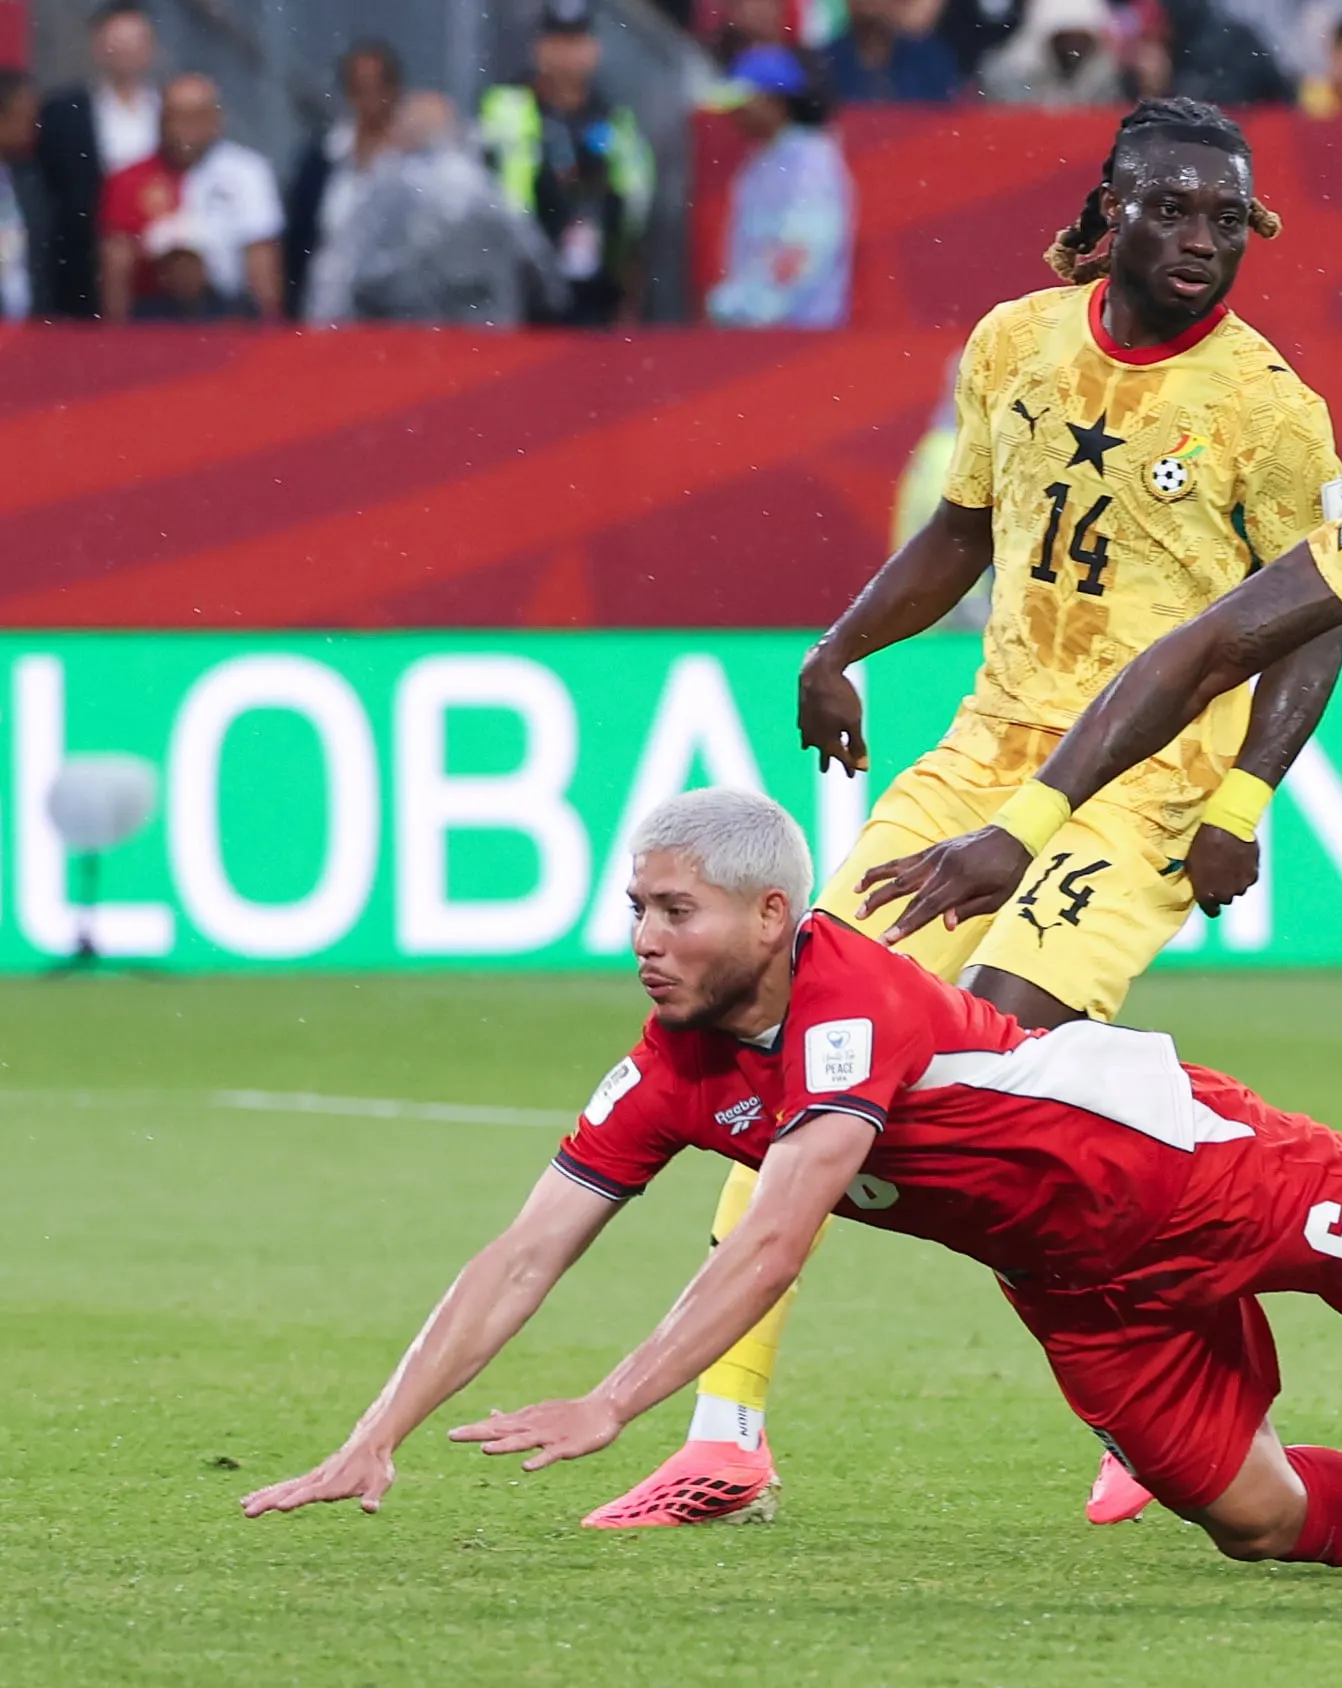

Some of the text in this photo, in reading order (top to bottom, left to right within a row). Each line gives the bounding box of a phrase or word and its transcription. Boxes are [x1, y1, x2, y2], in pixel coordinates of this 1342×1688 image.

[1031, 482, 1114, 597] 14
[1017, 853, 1112, 926] 14
[825, 1062, 854, 1074] PEACE
[714, 1095, 761, 1125] Reebo
